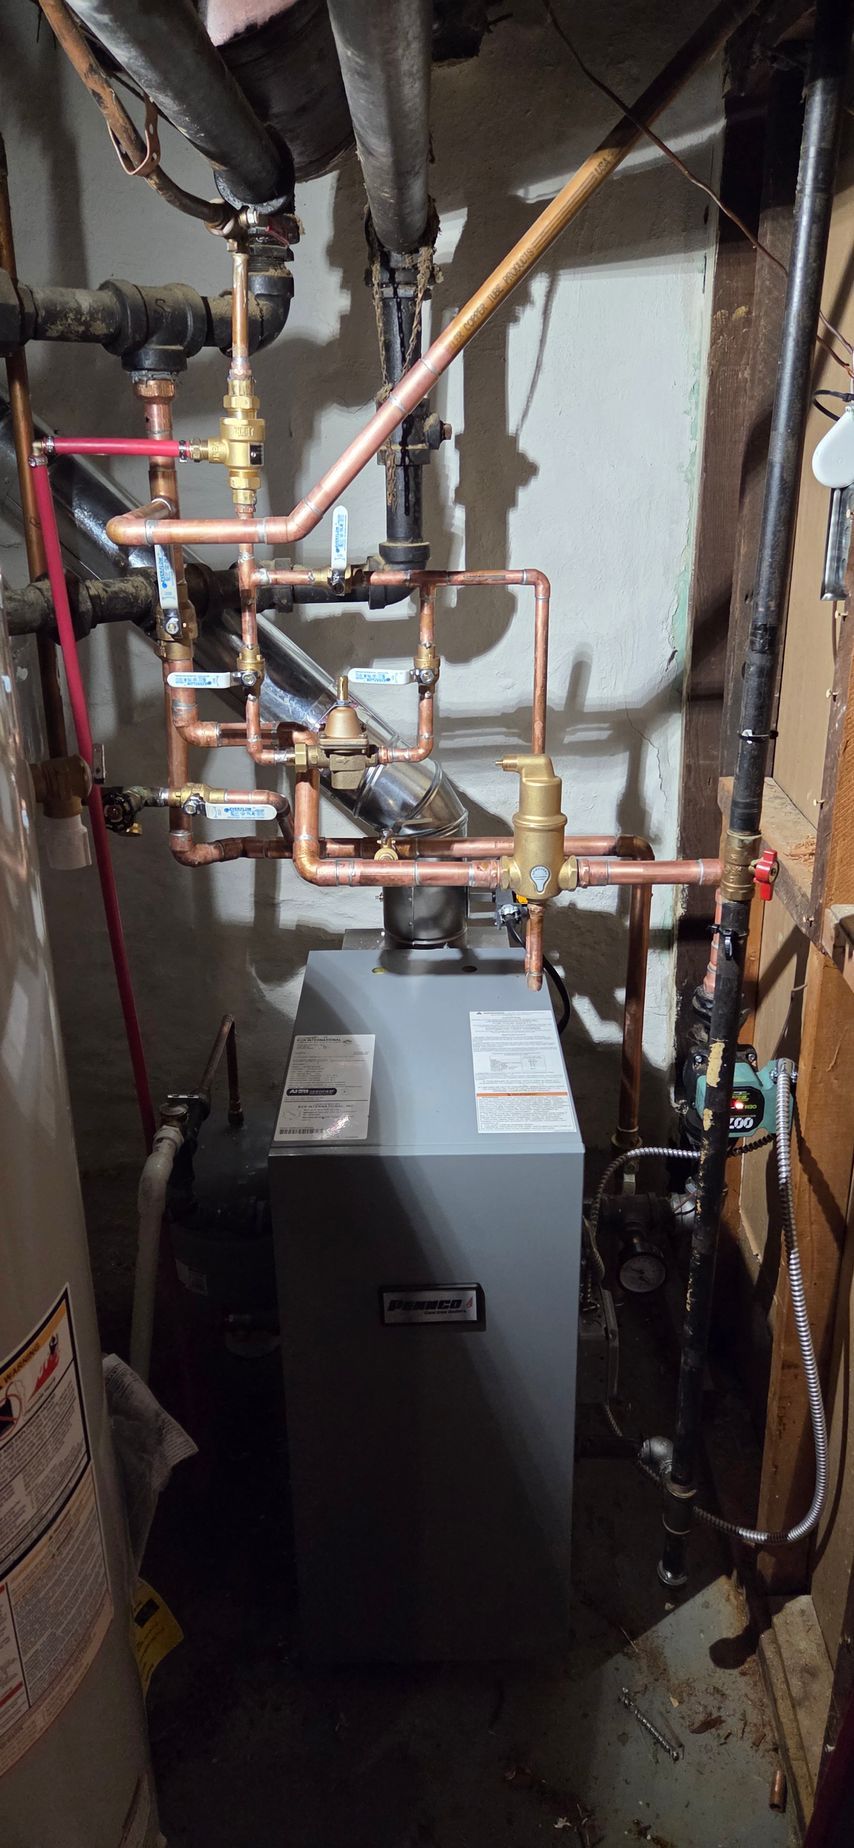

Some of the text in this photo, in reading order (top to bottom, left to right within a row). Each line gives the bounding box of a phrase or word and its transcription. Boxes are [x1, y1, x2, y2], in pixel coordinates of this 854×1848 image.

[463, 303, 488, 331] COPPER
[487, 283, 504, 304] TUBE
[502, 246, 536, 286] PRODUCTS
[4, 1342, 41, 1383] WARNING
